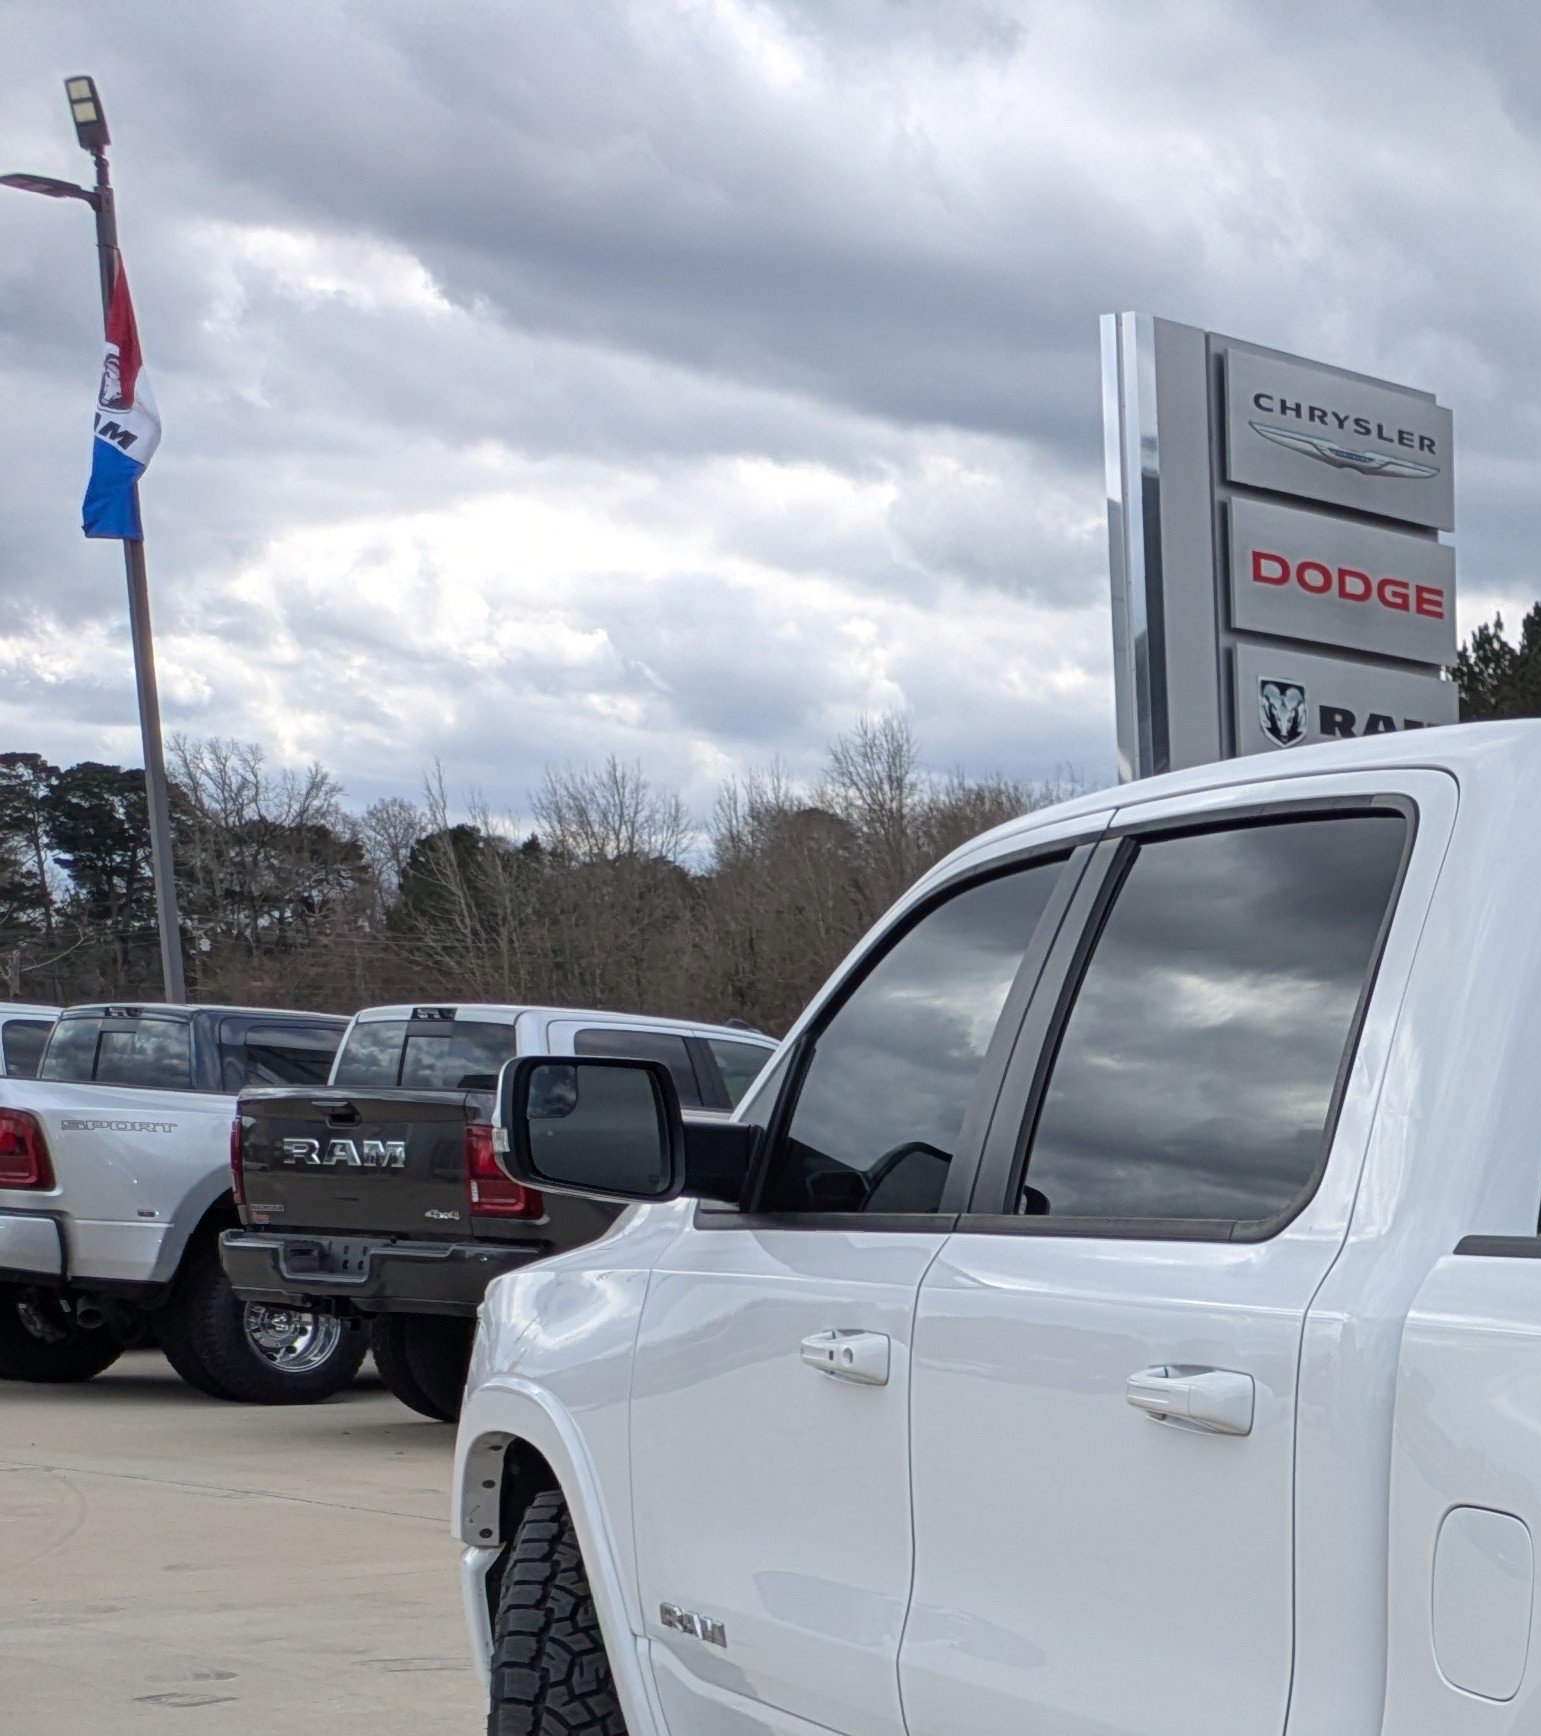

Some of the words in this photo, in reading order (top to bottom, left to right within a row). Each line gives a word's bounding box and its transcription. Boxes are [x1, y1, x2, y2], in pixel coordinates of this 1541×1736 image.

[1254, 393, 1437, 455] CHRYSLER
[1252, 550, 1445, 620] DODGE
[1319, 705, 1443, 738] RA
[61, 1119, 178, 1133] SPORT
[282, 1136, 406, 1168] RAM
